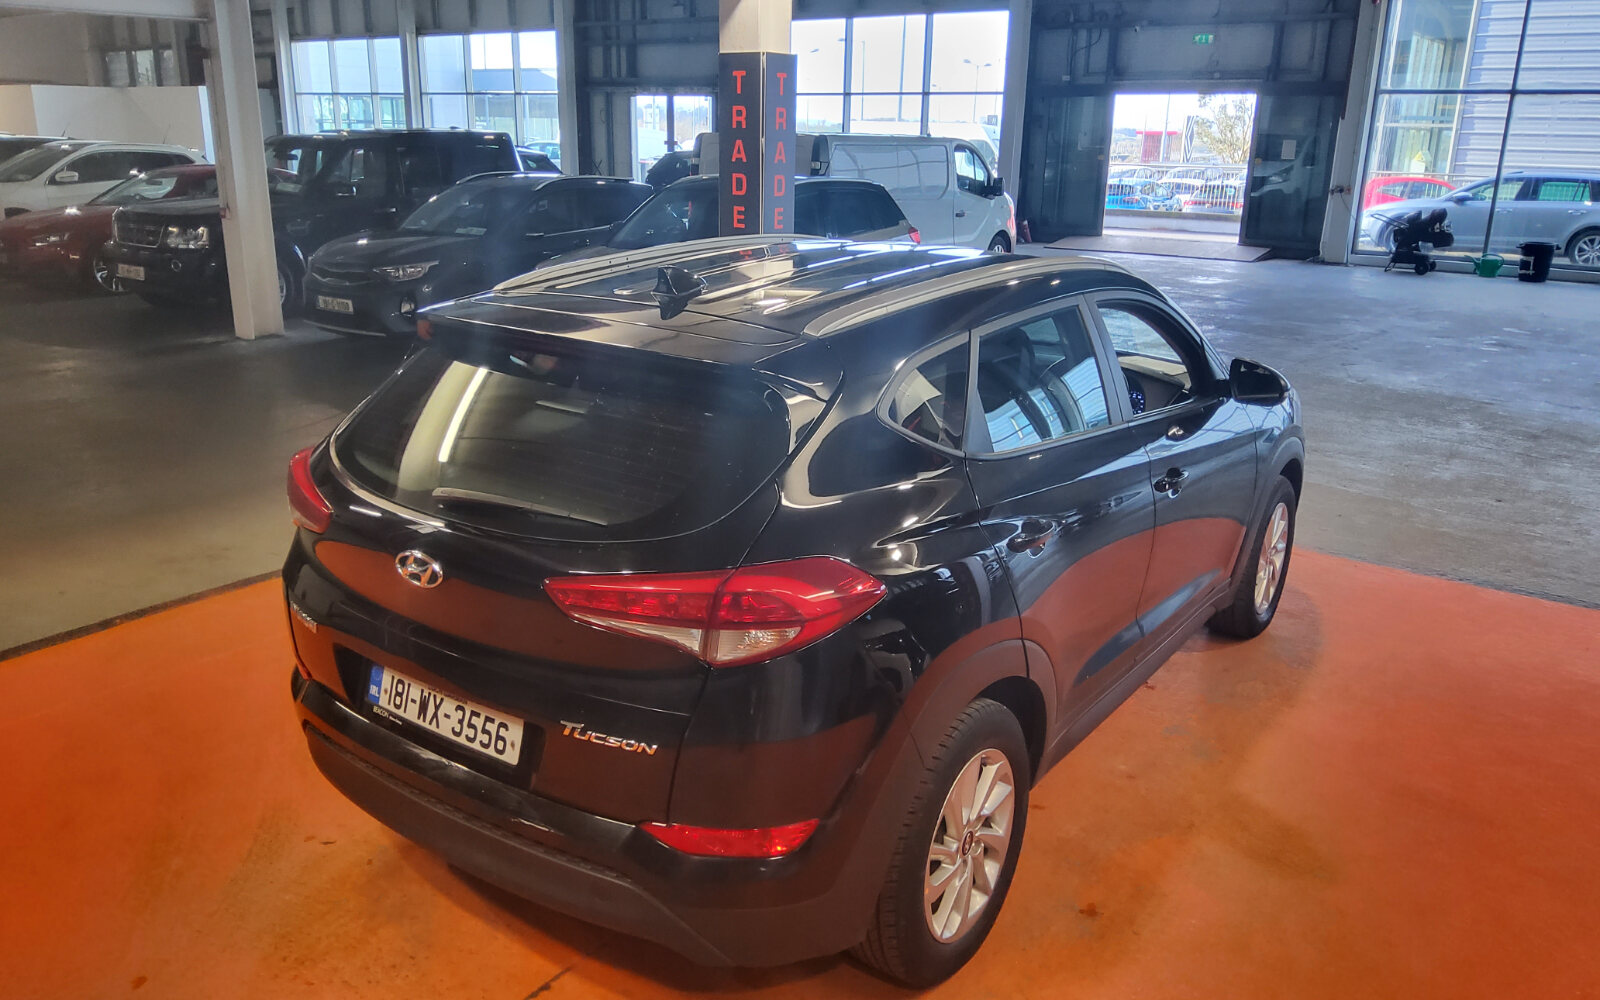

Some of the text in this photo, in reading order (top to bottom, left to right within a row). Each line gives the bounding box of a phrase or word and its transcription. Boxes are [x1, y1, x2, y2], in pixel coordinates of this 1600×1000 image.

[731, 70, 747, 228] TRADE
[773, 72, 788, 230] TRADE
[369, 684, 380, 698] IRL
[387, 675, 510, 756] 181-WX-3556
[560, 720, 658, 755] TUCSON
